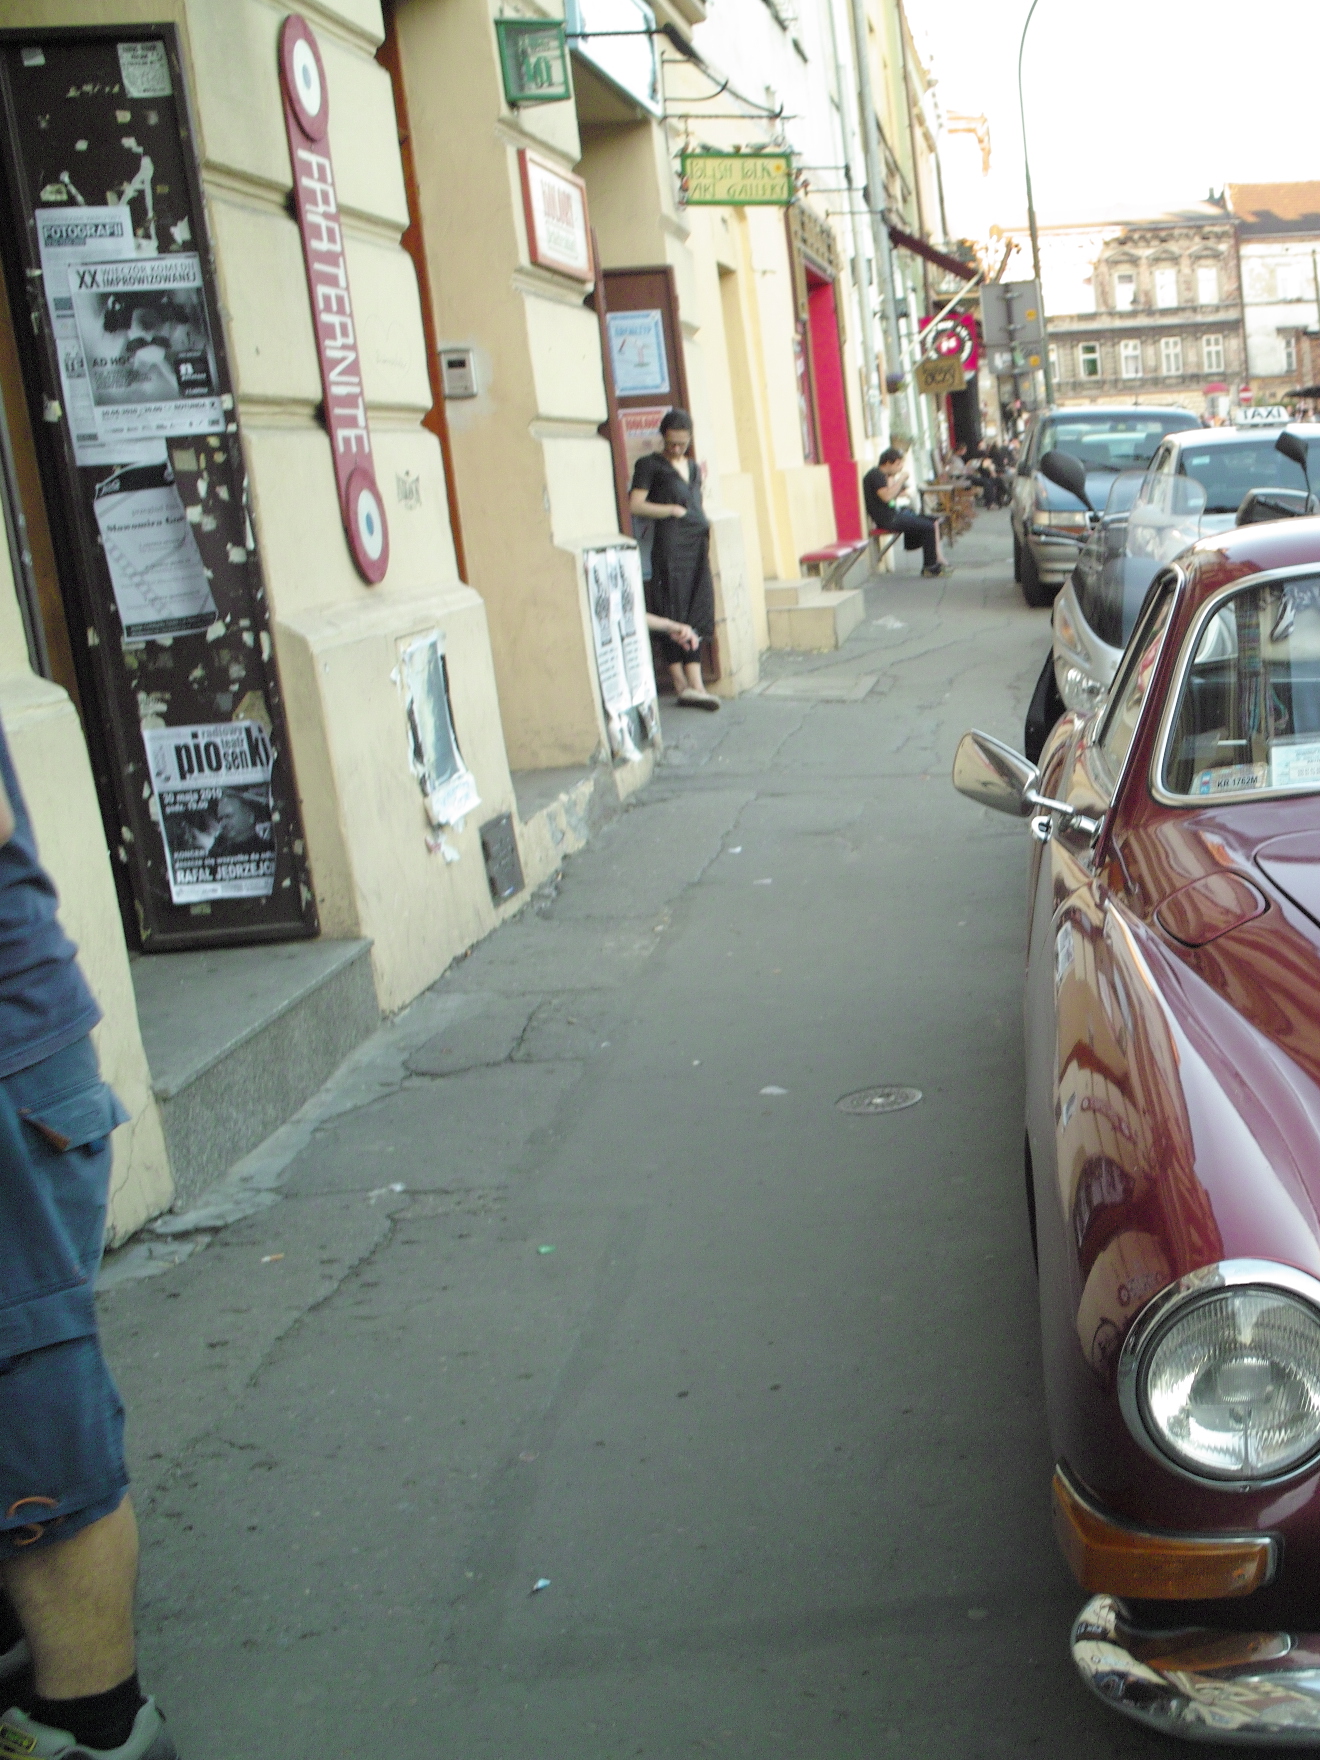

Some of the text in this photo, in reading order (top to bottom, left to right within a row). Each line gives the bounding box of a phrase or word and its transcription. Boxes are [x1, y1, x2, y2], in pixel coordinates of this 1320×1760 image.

[726, 181, 788, 199] GALLERY
[76, 267, 100, 290] XX
[102, 271, 197, 288] IMPROWIZOWANEJ
[297, 147, 370, 455] FRATERNITE
[1243, 406, 1281, 420] TAXI
[1217, 775, 1258, 788] KR 1762M
